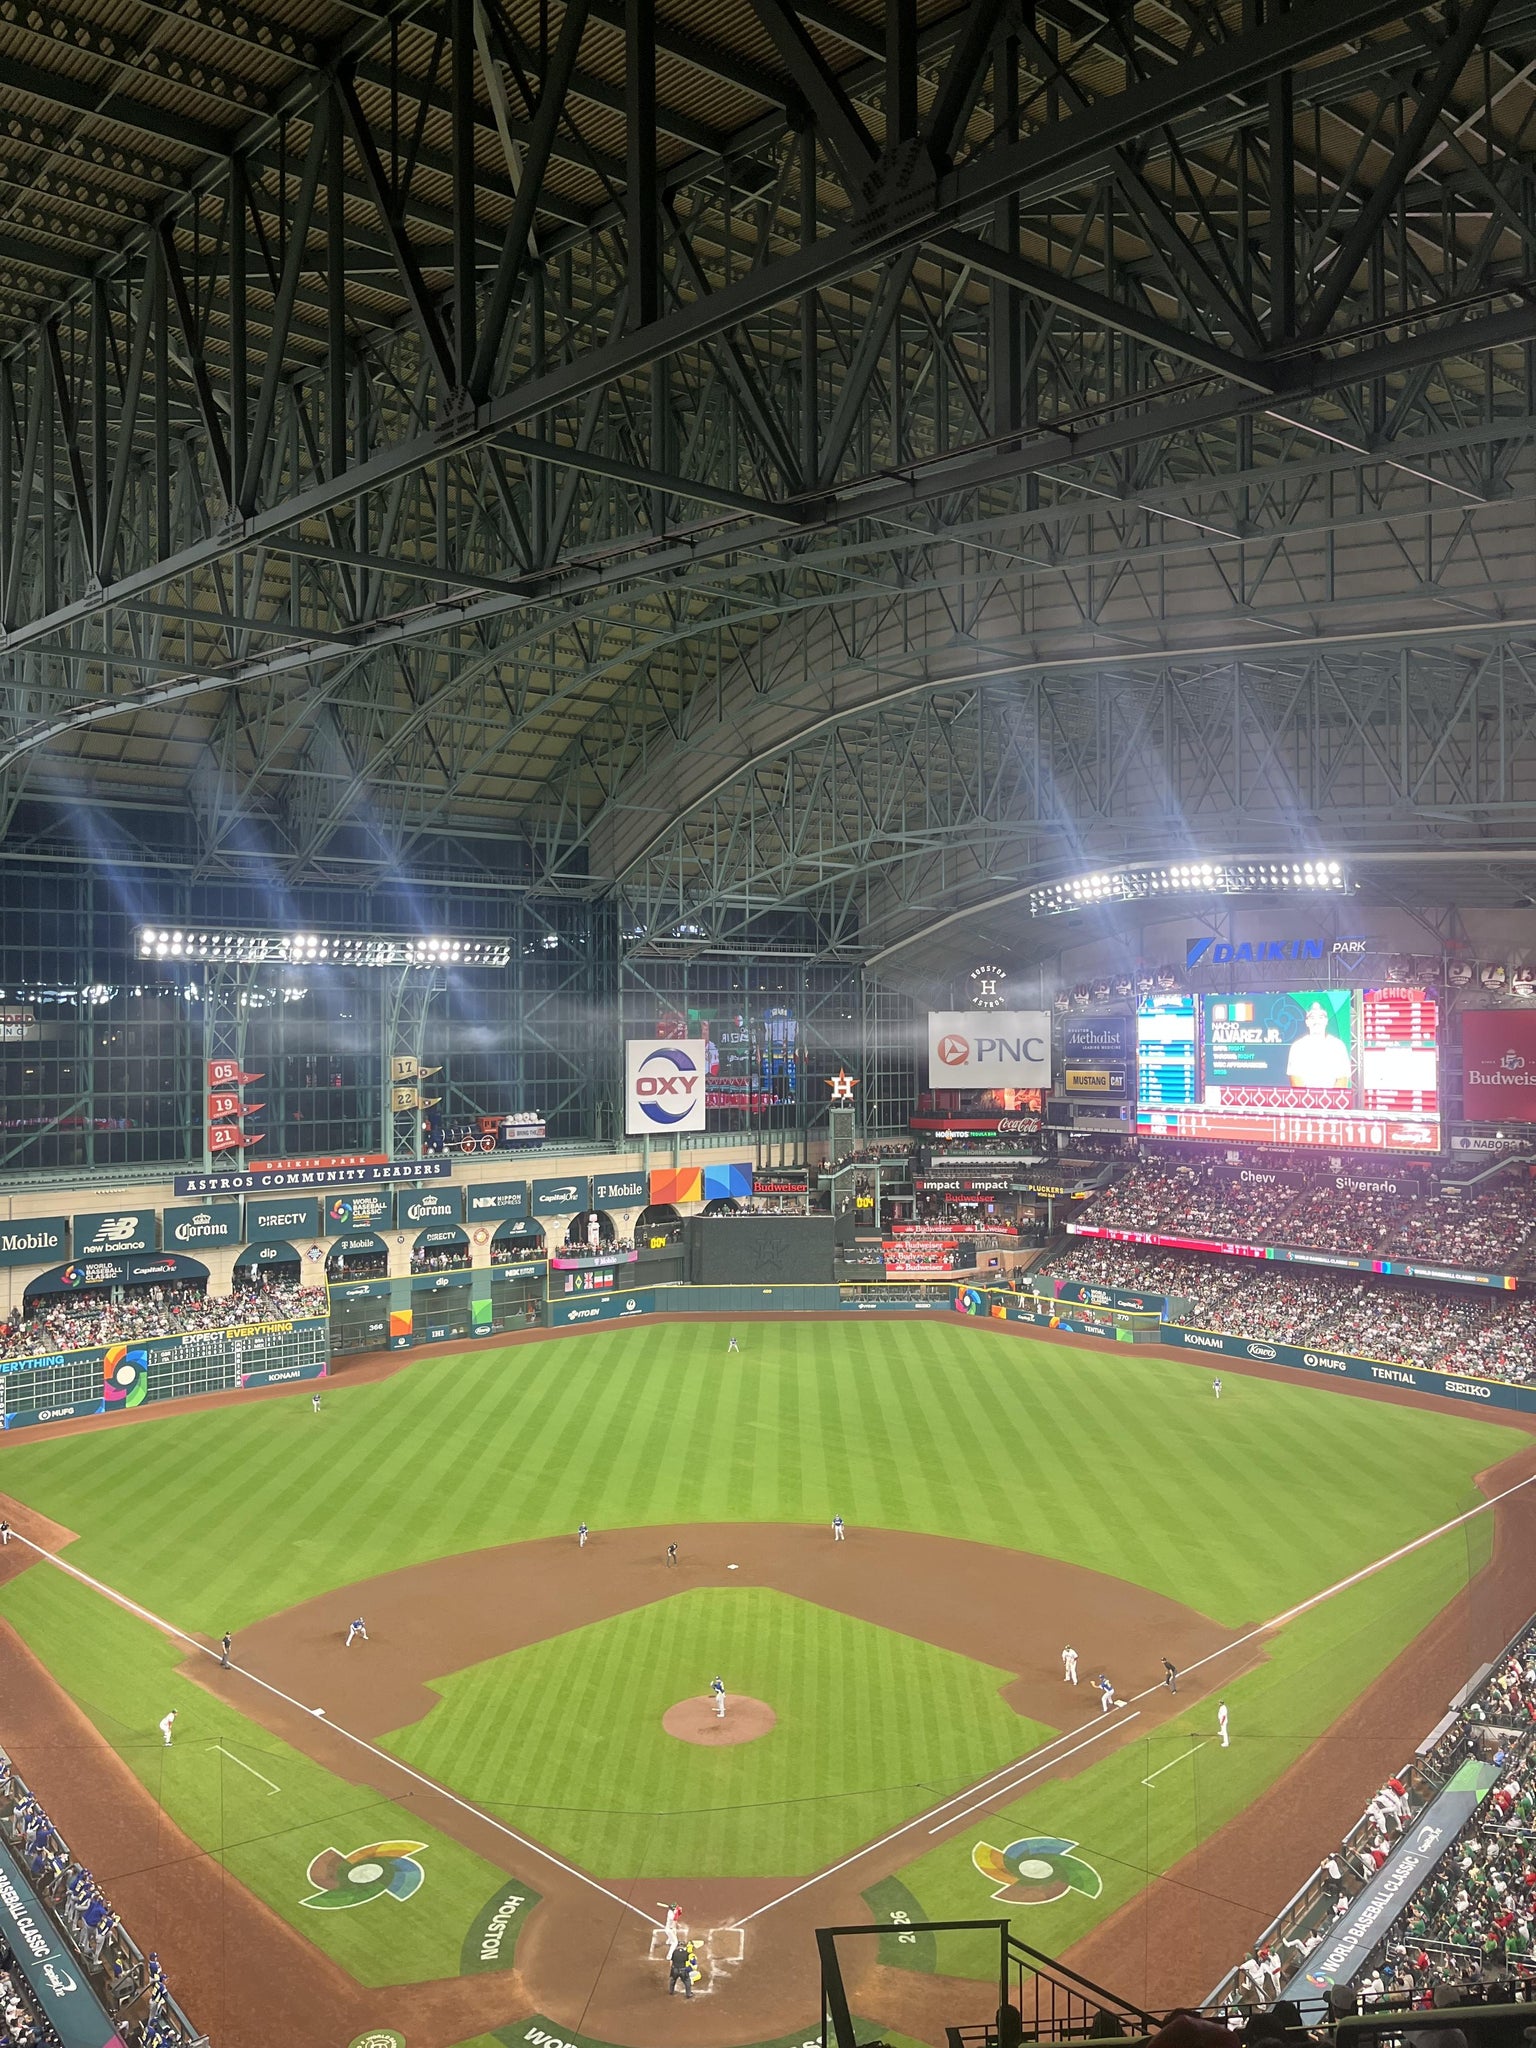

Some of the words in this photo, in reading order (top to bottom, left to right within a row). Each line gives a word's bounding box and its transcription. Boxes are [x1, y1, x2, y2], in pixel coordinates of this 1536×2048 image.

[1212, 938, 1324, 964] DAIKIN
[1332, 941, 1366, 953] PARK
[970, 965, 1006, 979] HOUSTON
[980, 980, 996, 995] H
[972, 996, 1005, 1008] ASTROS
[1069, 1031, 1120, 1044] Methodist
[1212, 1030, 1262, 1042] ALVAREZ
[1264, 1029, 1282, 1042] JR.
[974, 1038, 1044, 1062] PNC
[214, 1065, 232, 1079] 05
[398, 1062, 411, 1074] 17
[636, 1076, 698, 1095] OXY
[1073, 1076, 1106, 1085] MUSTANG
[1110, 1077, 1123, 1086] CAT
[216, 1099, 232, 1112] 19
[398, 1094, 411, 1105] 22
[215, 1130, 231, 1142] 21
[1345, 1125, 1354, 1142] 1
[1358, 1126, 1366, 1143] 1
[1370, 1126, 1382, 1144] 0
[267, 1160, 320, 1169] DAIKIN
[186, 1177, 253, 1191] ASTROS
[262, 1169, 366, 1185] COMMUNITY
[373, 1164, 441, 1178] LEADERS
[608, 1183, 642, 1197] Mobile
[753, 1182, 808, 1191] Budweiser
[924, 1181, 960, 1190] impact
[972, 1181, 1008, 1190] impact
[1028, 1185, 1064, 1194] PLUCKERS
[1336, 1178, 1397, 1194] Silverado
[856, 1197, 873, 1208] 0:04
[945, 1193, 995, 1202] Budweiser
[408, 1204, 452, 1221] Corona
[258, 1213, 306, 1227] DIRECTV
[175, 1223, 228, 1241] Corona
[427, 1232, 456, 1241] DIRECTV
[1, 1233, 58, 1250] Mobile
[84, 1245, 104, 1254] new
[105, 1241, 145, 1252] balance
[349, 1239, 374, 1249] Mobile
[650, 1238, 666, 1249] 0:04
[260, 1248, 277, 1259] dip
[86, 1267, 123, 1275] BASEBALL
[436, 1278, 449, 1286] dip
[182, 1331, 225, 1344] EXPECT
[226, 1322, 293, 1338] EVERYTHING
[1084, 1325, 1105, 1335] TENTIAL
[1184, 1334, 1223, 1349] KONAMI
[1250, 1344, 1275, 1357] Kowa
[1319, 1358, 1346, 1371] MUFG
[268, 1371, 300, 1381] KONAMI
[1371, 1367, 1416, 1385] TENTIAL
[1445, 1380, 1491, 1398] SEIKO
[52, 1407, 74, 1418] MUFG
[1320, 1935, 1358, 1972] WORLD
[1348, 1892, 1394, 1938] BASEBALL
[1384, 1856, 1419, 1892] CLASSIC
[480, 1895, 525, 1960] HOUSTON
[890, 1911, 916, 1944] 226
[17, 1917, 50, 1958] CLASSIC
